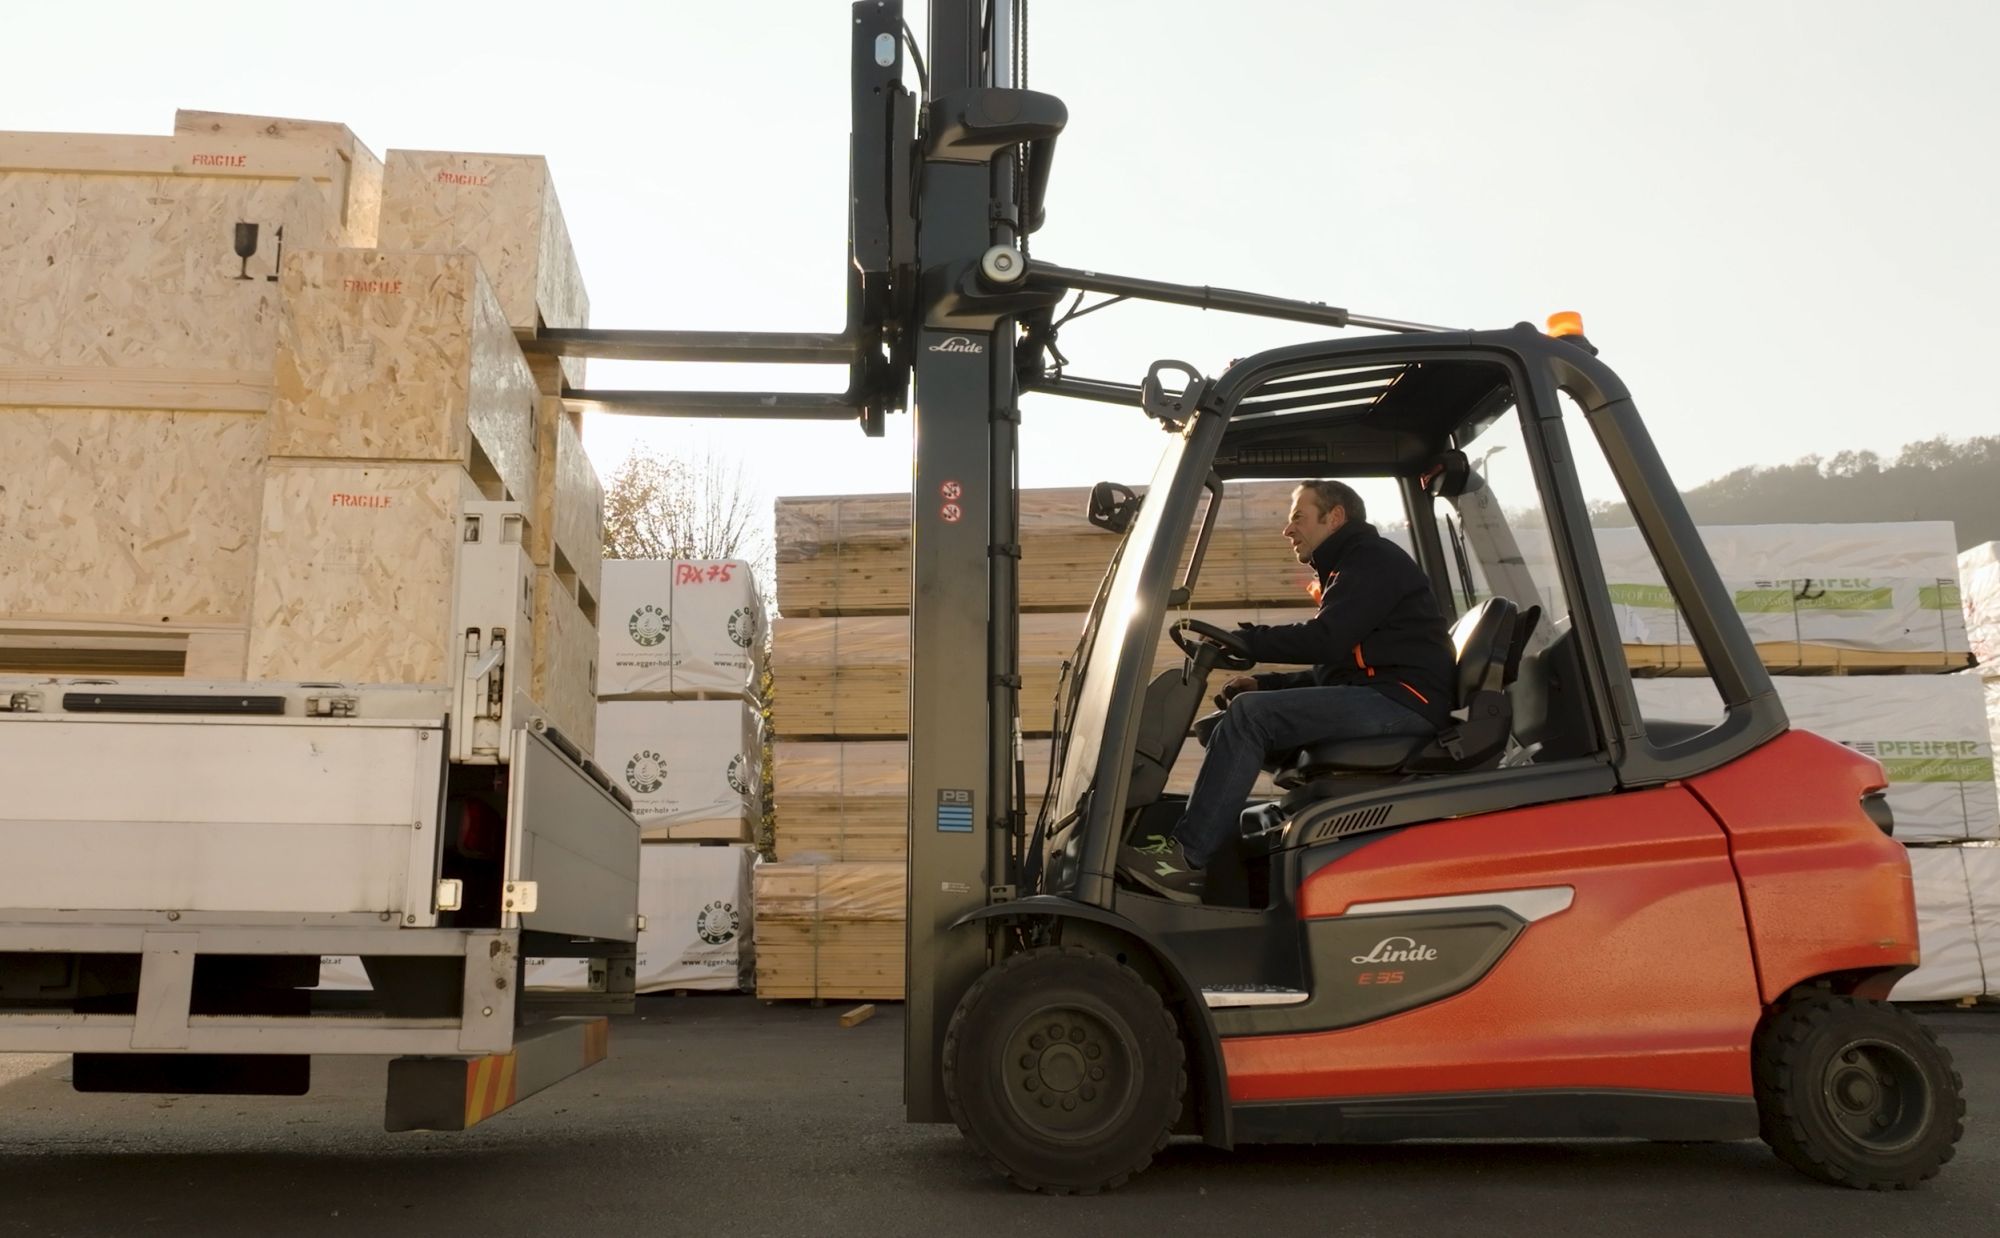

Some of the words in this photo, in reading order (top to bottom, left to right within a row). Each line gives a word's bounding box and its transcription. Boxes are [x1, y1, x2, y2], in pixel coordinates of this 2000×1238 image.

[192, 154, 247, 167] FRAGILE
[438, 171, 489, 187] FRAGILE
[343, 280, 402, 294] FRAGILE
[928, 336, 983, 353] Linde
[332, 494, 392, 508] FRAGILE
[635, 604, 671, 633] EGGER
[629, 622, 660, 646] HOLZ
[1877, 740, 1977, 756] PFEIFER
[633, 750, 668, 779] EGGER
[626, 768, 657, 793] HOLZ
[704, 901, 739, 930] EGGER
[697, 919, 728, 943] HOLZ
[1351, 936, 1438, 964] Linde
[1358, 972, 1372, 985] E
[1376, 971, 1404, 984] 35
